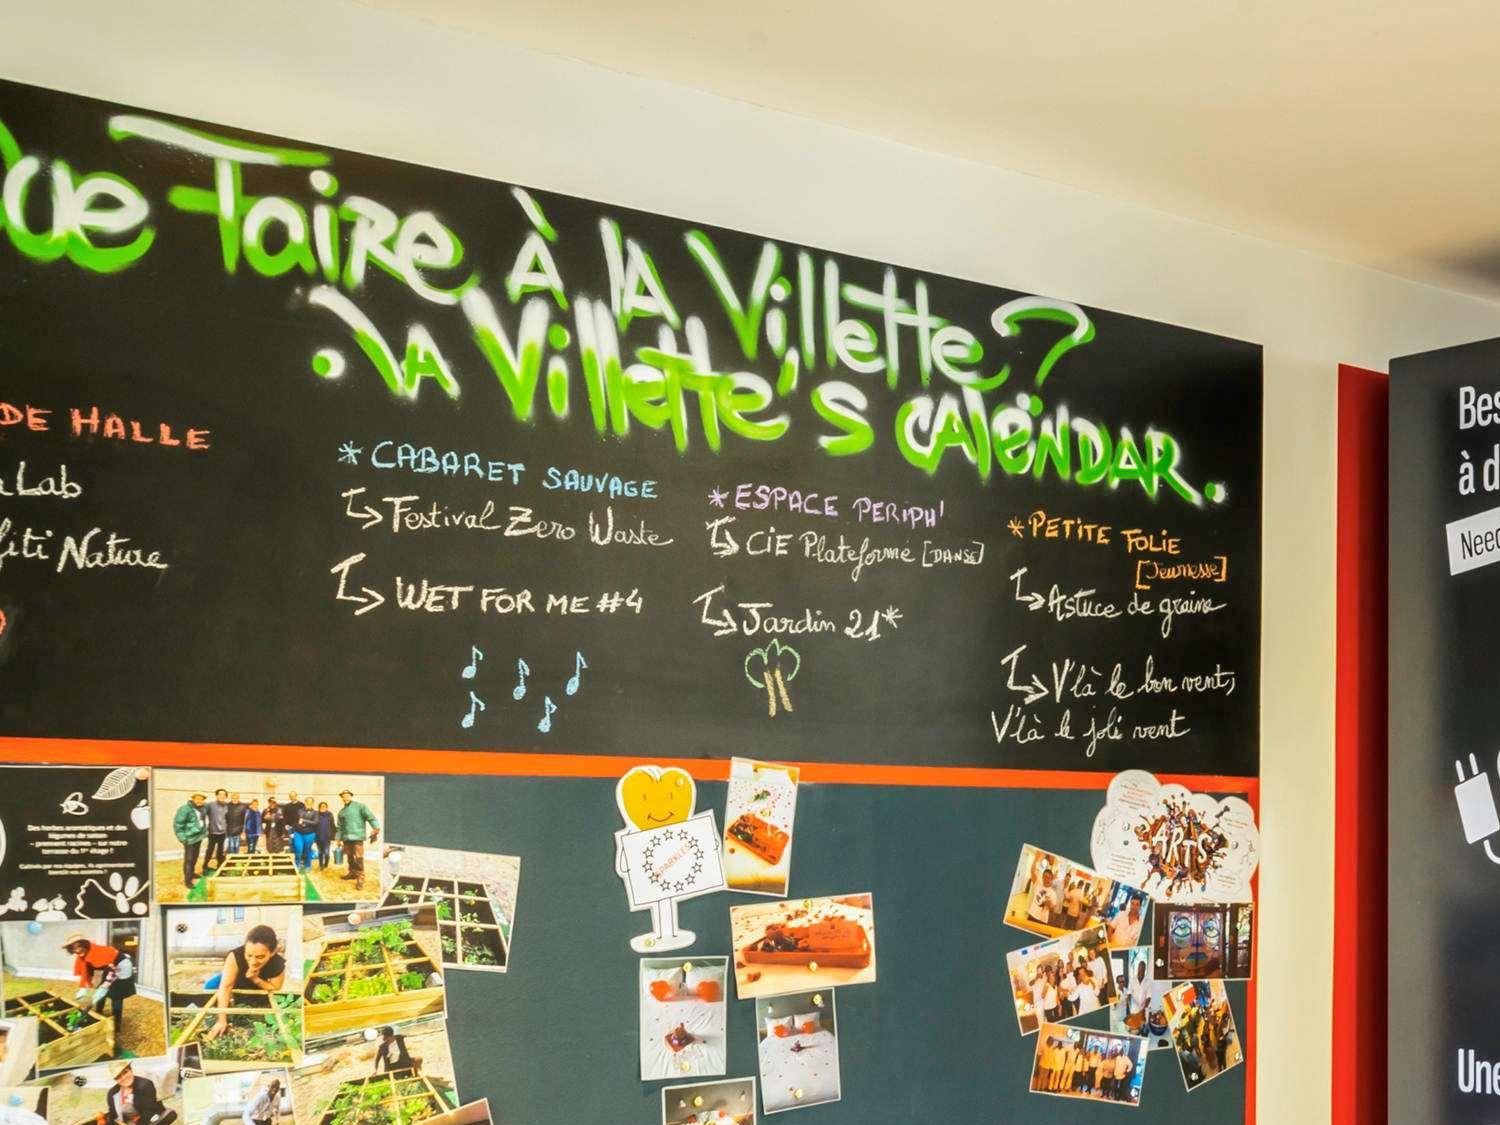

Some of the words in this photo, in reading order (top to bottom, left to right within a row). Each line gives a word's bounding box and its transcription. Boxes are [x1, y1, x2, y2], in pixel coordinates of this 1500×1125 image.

[68, 405, 211, 450] HALLE
[370, 441, 526, 486] CABARET
[541, 466, 659, 499] SAUVAGE
[1458, 450, 1476, 496] à
[382, 494, 502, 534] Festival
[503, 505, 576, 541] Zero
[588, 506, 674, 546] Waste
[734, 483, 839, 516] ESPACE
[56, 527, 170, 573] Nature
[396, 576, 475, 614] WET
[480, 587, 536, 615] FOR
[545, 593, 591, 616] ME
[595, 588, 644, 615] #4
[1048, 583, 1123, 622] Astuce
[1126, 592, 1156, 616] de
[1158, 590, 1228, 639] graine
[741, 602, 836, 637] Jardin
[1106, 663, 1135, 700] le
[1137, 654, 1179, 694] bon
[1054, 708, 1076, 741] le
[1132, 708, 1192, 740] vent
[1152, 822, 1213, 868] ARTS
